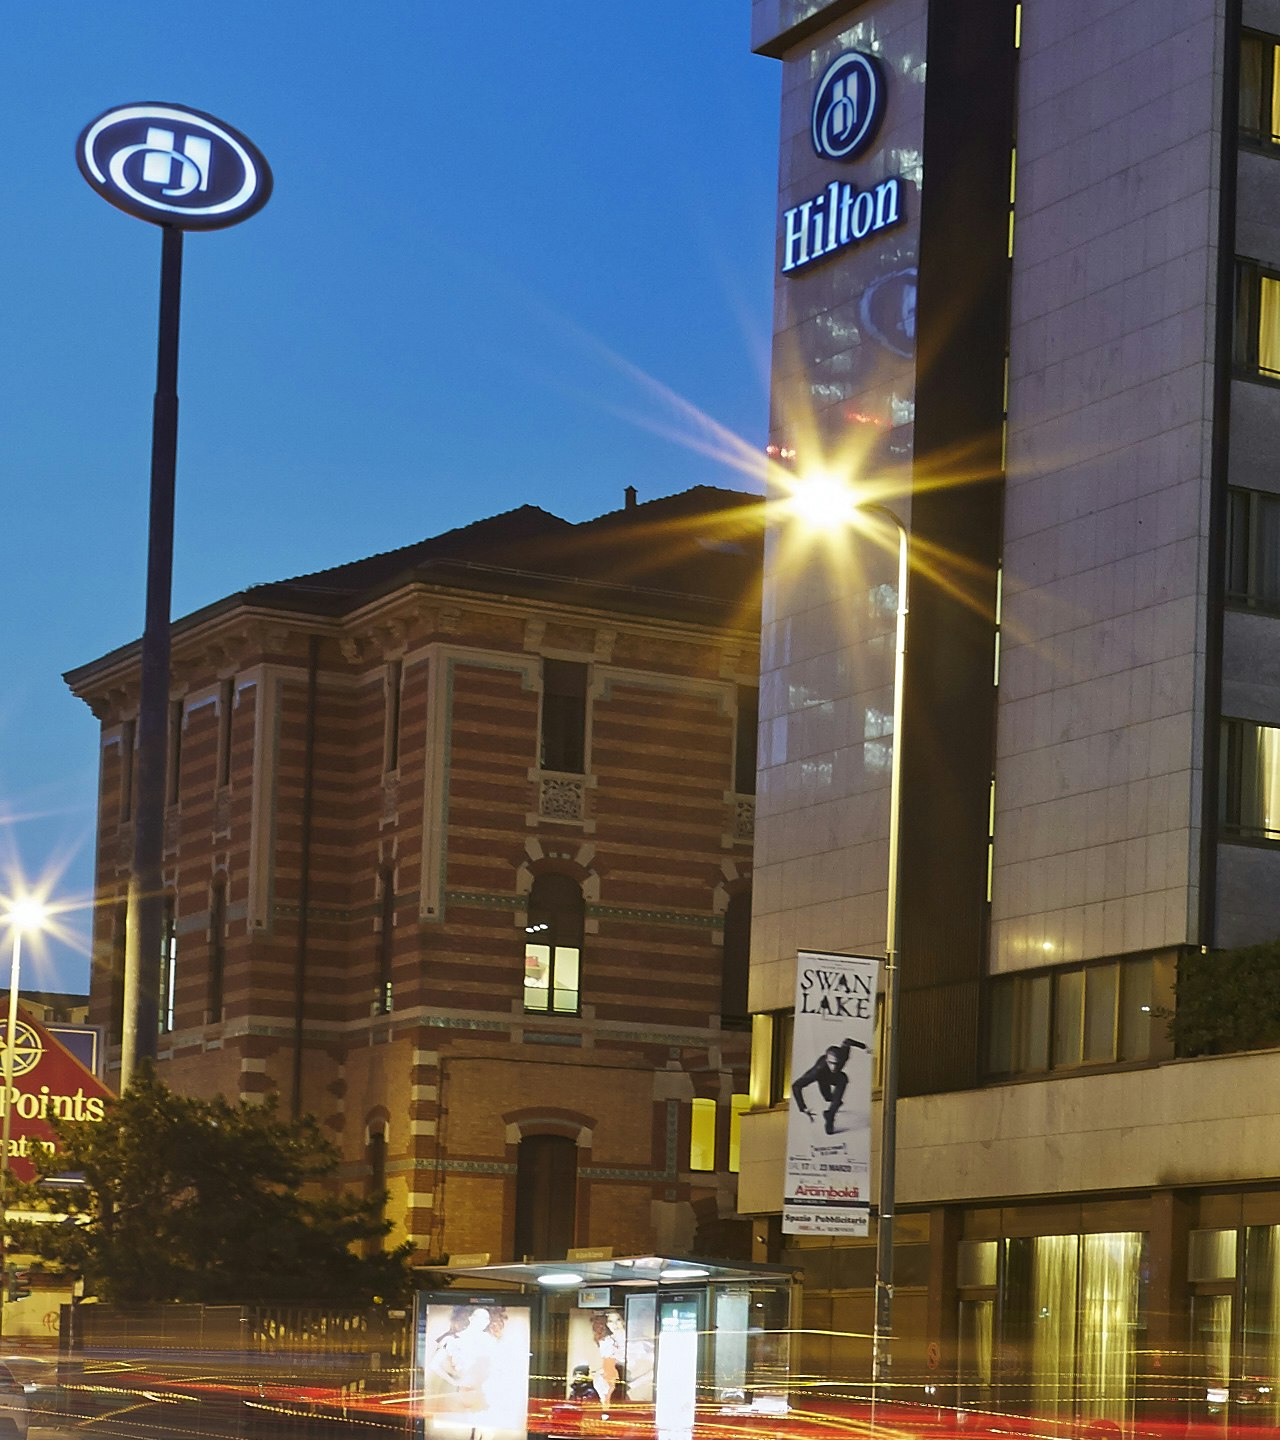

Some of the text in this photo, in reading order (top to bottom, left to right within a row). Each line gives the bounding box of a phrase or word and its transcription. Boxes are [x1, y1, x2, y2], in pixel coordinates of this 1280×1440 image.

[782, 178, 899, 272] Hilton
[801, 969, 873, 996] SWAN
[801, 993, 871, 1019] LAKE
[0, 1085, 105, 1122] Points
